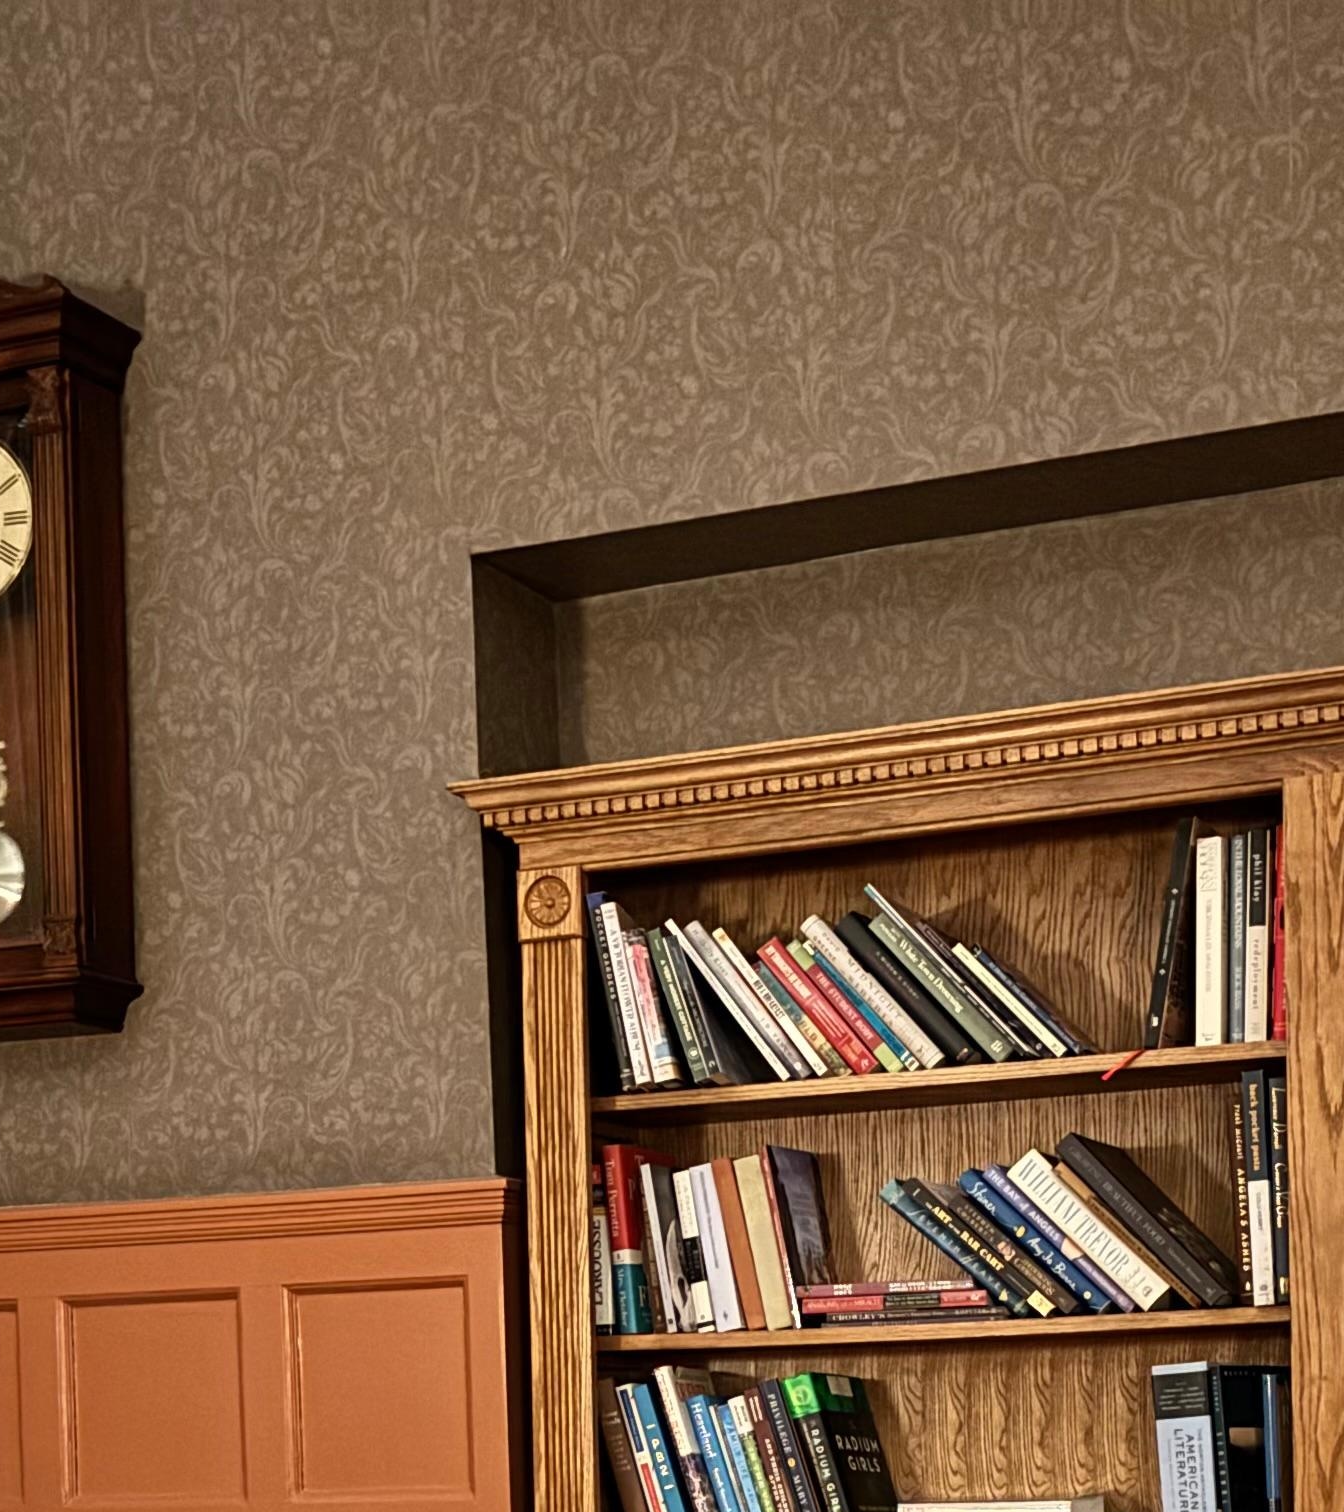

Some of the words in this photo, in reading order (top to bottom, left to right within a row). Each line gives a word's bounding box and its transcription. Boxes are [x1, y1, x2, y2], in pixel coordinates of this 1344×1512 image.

[1252, 853, 1263, 875] phil
[1251, 879, 1262, 902] klay
[592, 908, 608, 947] POCKET
[601, 952, 618, 1000] GARDENS
[811, 934, 837, 962] GREENE
[821, 931, 841, 952] DAVID
[896, 938, 920, 963] White
[915, 958, 937, 981] Town
[814, 971, 830, 988] THE
[827, 986, 858, 1021] STUDENT
[854, 1019, 874, 1041] BODY
[1248, 1083, 1258, 1107] back
[1248, 1109, 1260, 1142] pocket
[604, 1159, 617, 1185] Tom
[1250, 1144, 1262, 1171] pasta
[607, 1188, 621, 1237] Perrotta
[966, 1178, 1005, 1216] Shiner
[986, 1169, 1004, 1187] THE
[1002, 1184, 1020, 1202] BAY
[1026, 1208, 1061, 1241] ANGELS
[1015, 1157, 1082, 1225] WILLIAM
[1070, 1213, 1133, 1277] TREVOR
[1236, 1167, 1248, 1226] ANGELA'S
[906, 1204, 963, 1255] SEVENTH
[959, 1248, 1013, 1297] HEAVE
[929, 1204, 953, 1225] ART
[959, 1230, 981, 1251] BAR
[977, 1246, 1005, 1272] CART
[1239, 1231, 1250, 1271] ASHES
[591, 1218, 603, 1306] LAROUSSE
[690, 1402, 718, 1458] Heartland
[765, 1392, 794, 1454] PRIVILEGE
[835, 1435, 881, 1453] RADIUM
[808, 1428, 833, 1478] RADIUM
[848, 1456, 881, 1473] GIRLS
[1184, 1433, 1201, 1510] AMERICAN
[791, 1473, 810, 1505] MARY
